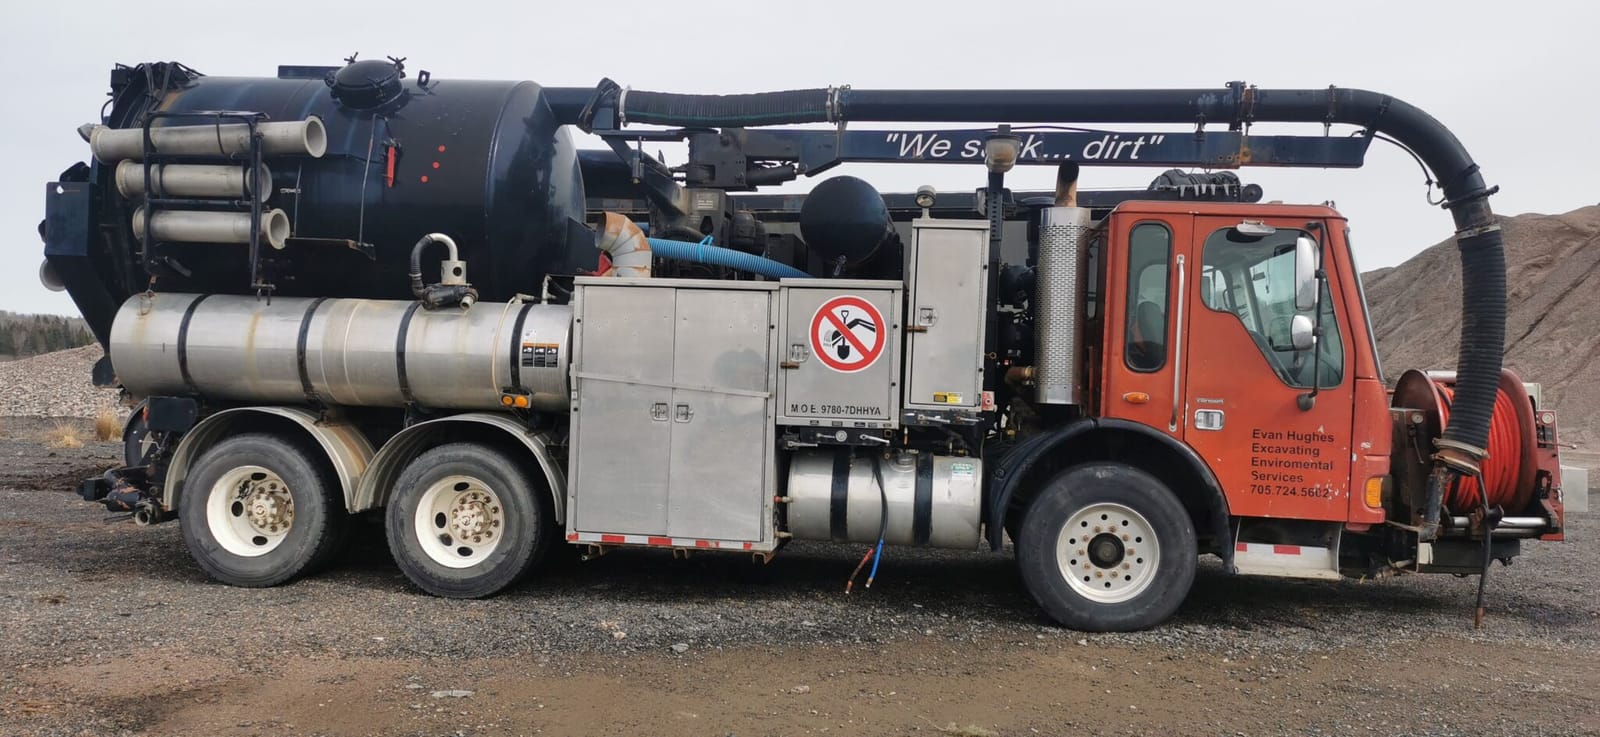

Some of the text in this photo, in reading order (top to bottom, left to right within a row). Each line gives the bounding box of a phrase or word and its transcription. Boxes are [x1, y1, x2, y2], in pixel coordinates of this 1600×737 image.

[886, 134, 1165, 160] "We sk... dirt"
[1252, 429, 1335, 444] Evan Hughes
[1252, 443, 1320, 457] Excavating
[1251, 457, 1334, 470] Enviromental
[1251, 470, 1304, 482] Services
